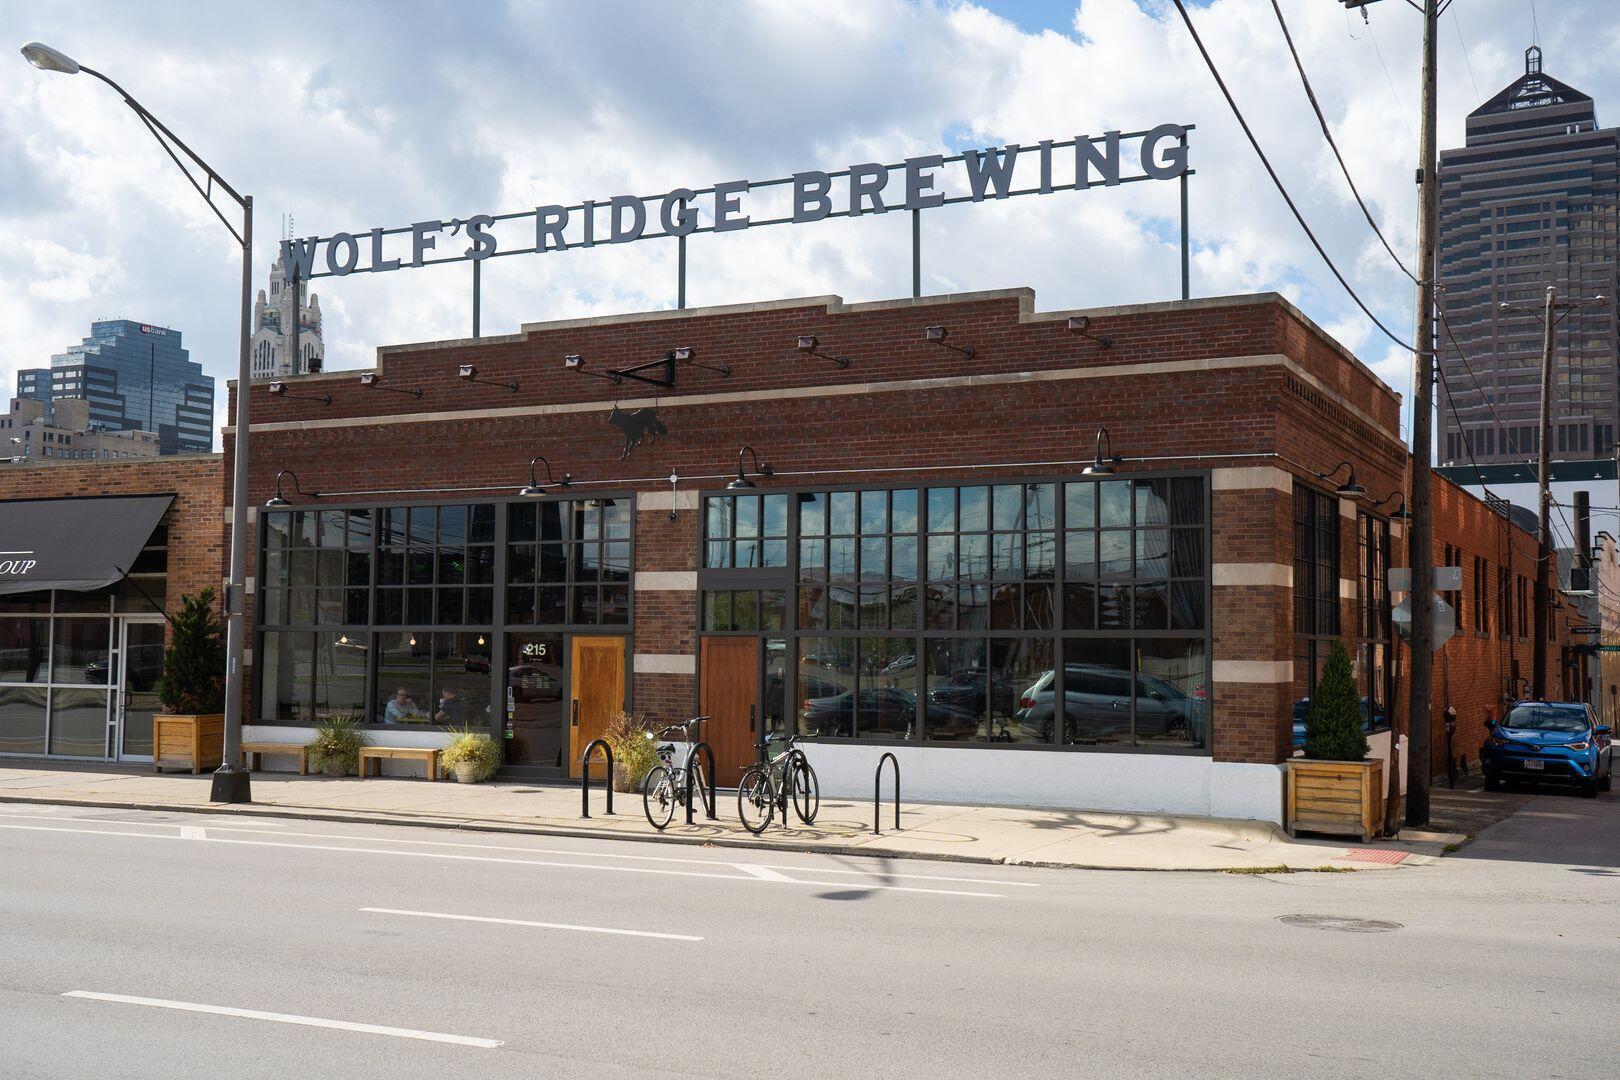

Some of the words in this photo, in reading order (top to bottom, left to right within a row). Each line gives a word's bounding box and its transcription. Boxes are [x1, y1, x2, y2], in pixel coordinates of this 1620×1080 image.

[280, 214, 497, 280] WOLF'S
[535, 180, 750, 253] RIDGE
[793, 123, 1189, 222] BREWING
[526, 643, 546, 656] 215
